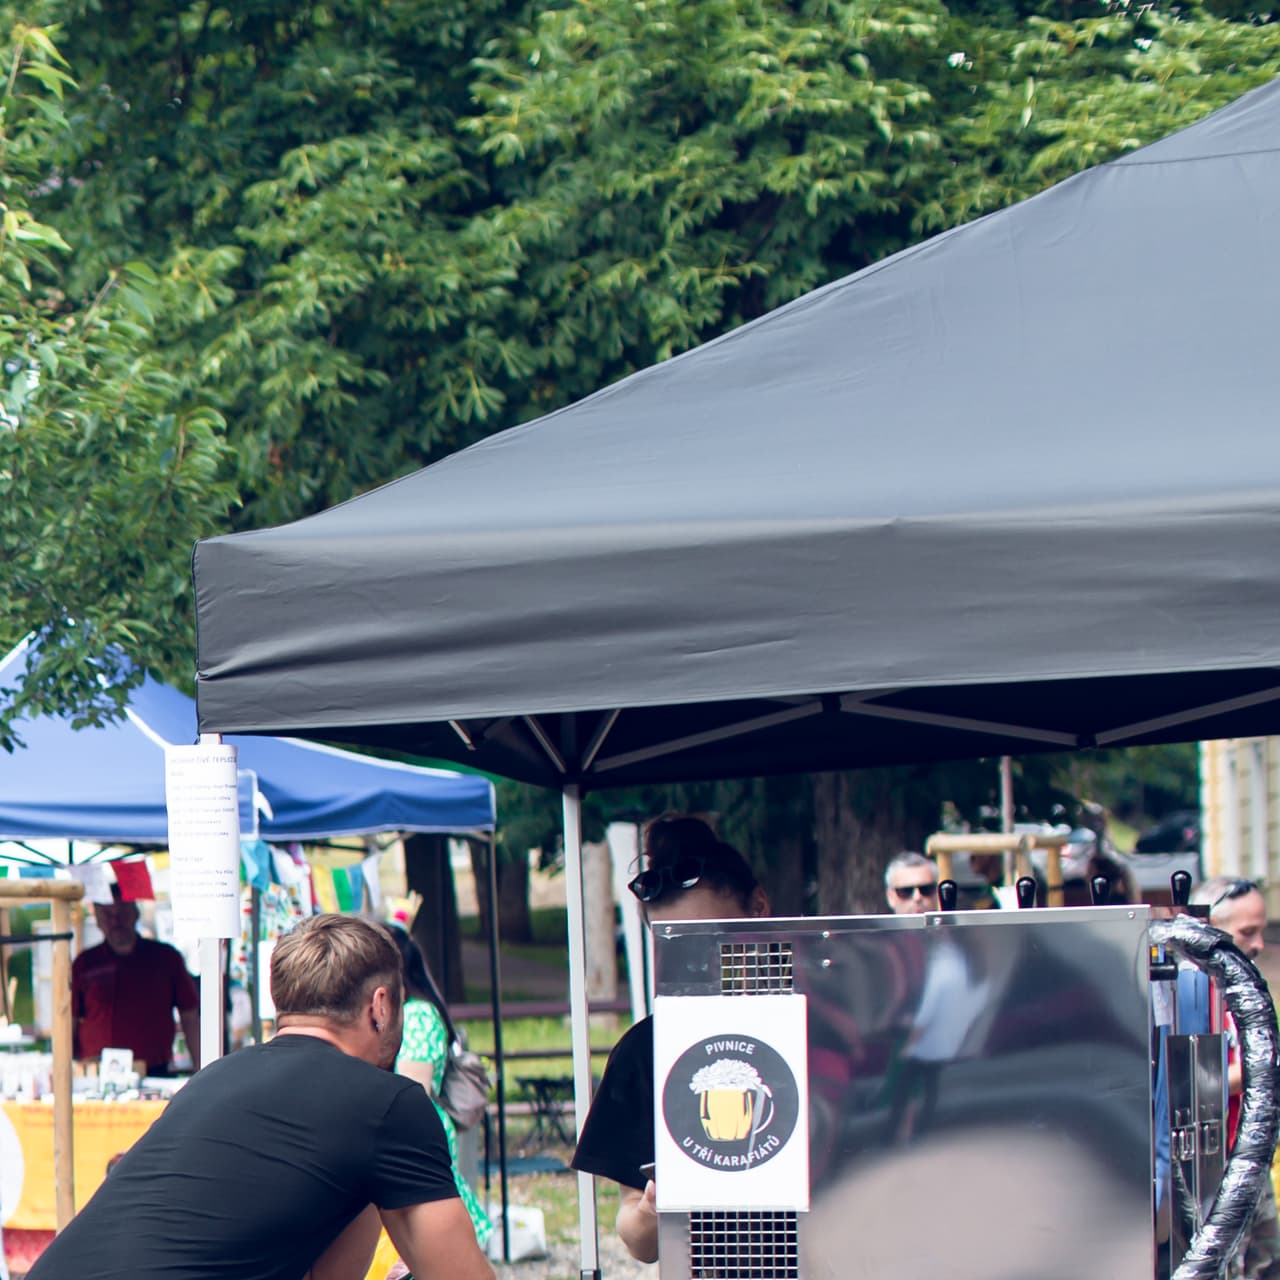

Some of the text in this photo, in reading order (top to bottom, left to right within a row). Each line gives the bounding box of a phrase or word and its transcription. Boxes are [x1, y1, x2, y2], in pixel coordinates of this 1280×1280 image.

[705, 1040, 755, 1055] PIVNICE
[682, 1134, 780, 1167] U TŘÍ KARAFIÁTŮ
